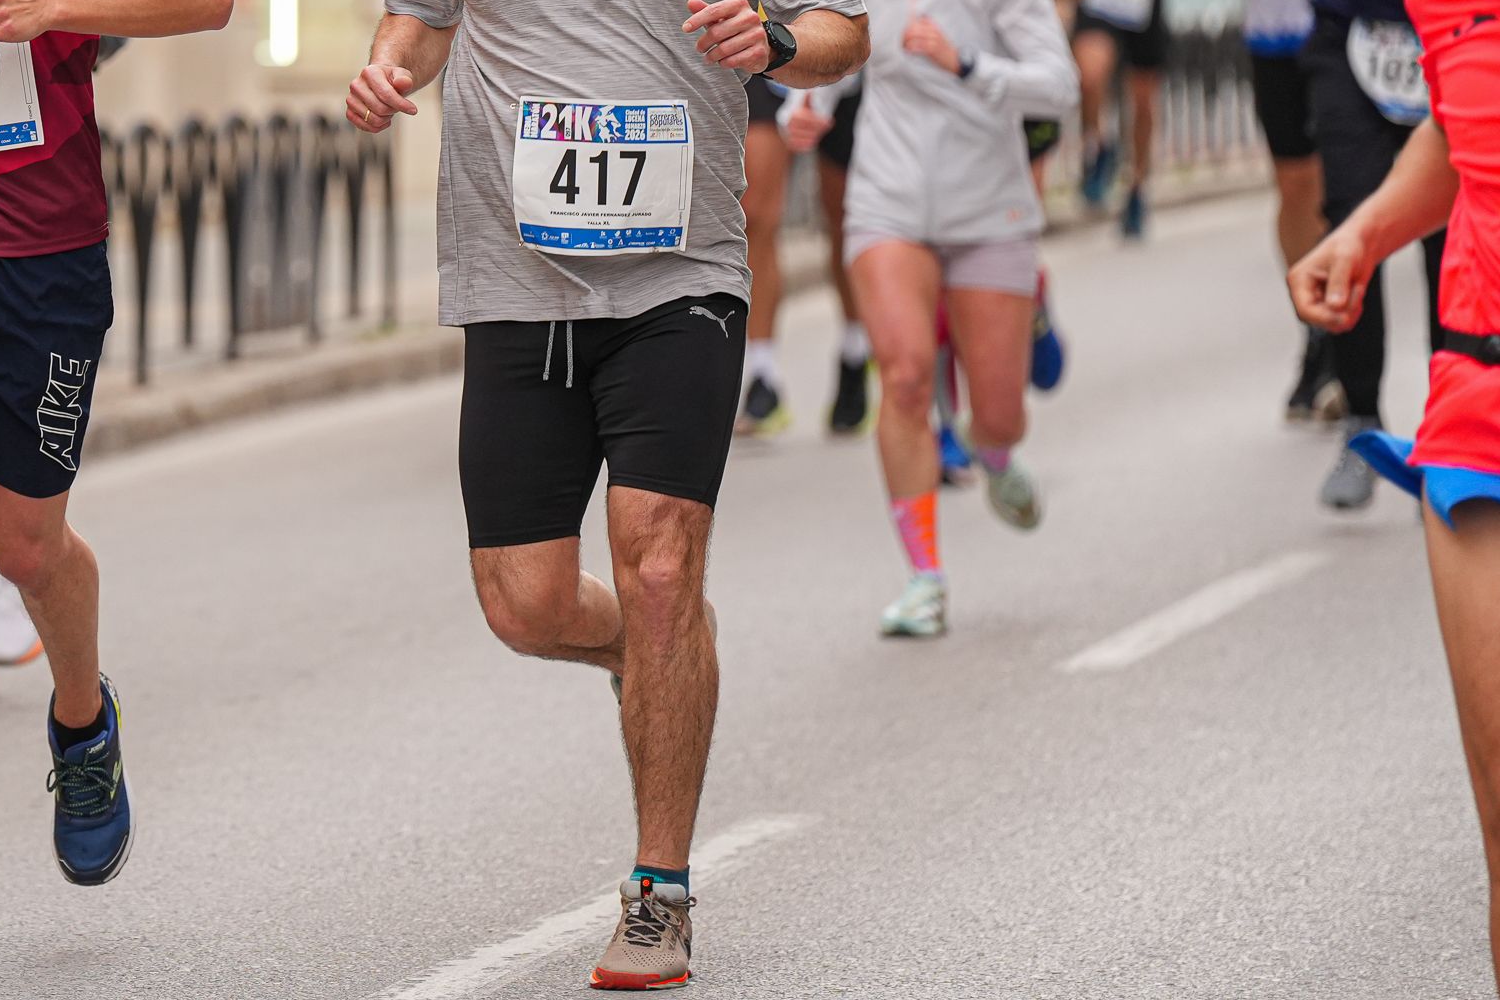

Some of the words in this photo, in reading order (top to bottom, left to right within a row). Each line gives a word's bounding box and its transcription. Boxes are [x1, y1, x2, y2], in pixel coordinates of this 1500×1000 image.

[540, 103, 594, 141] 21K
[650, 113, 678, 121] carreras
[650, 118, 683, 128] populares
[625, 129, 646, 141] 2026
[549, 149, 647, 206] 417
